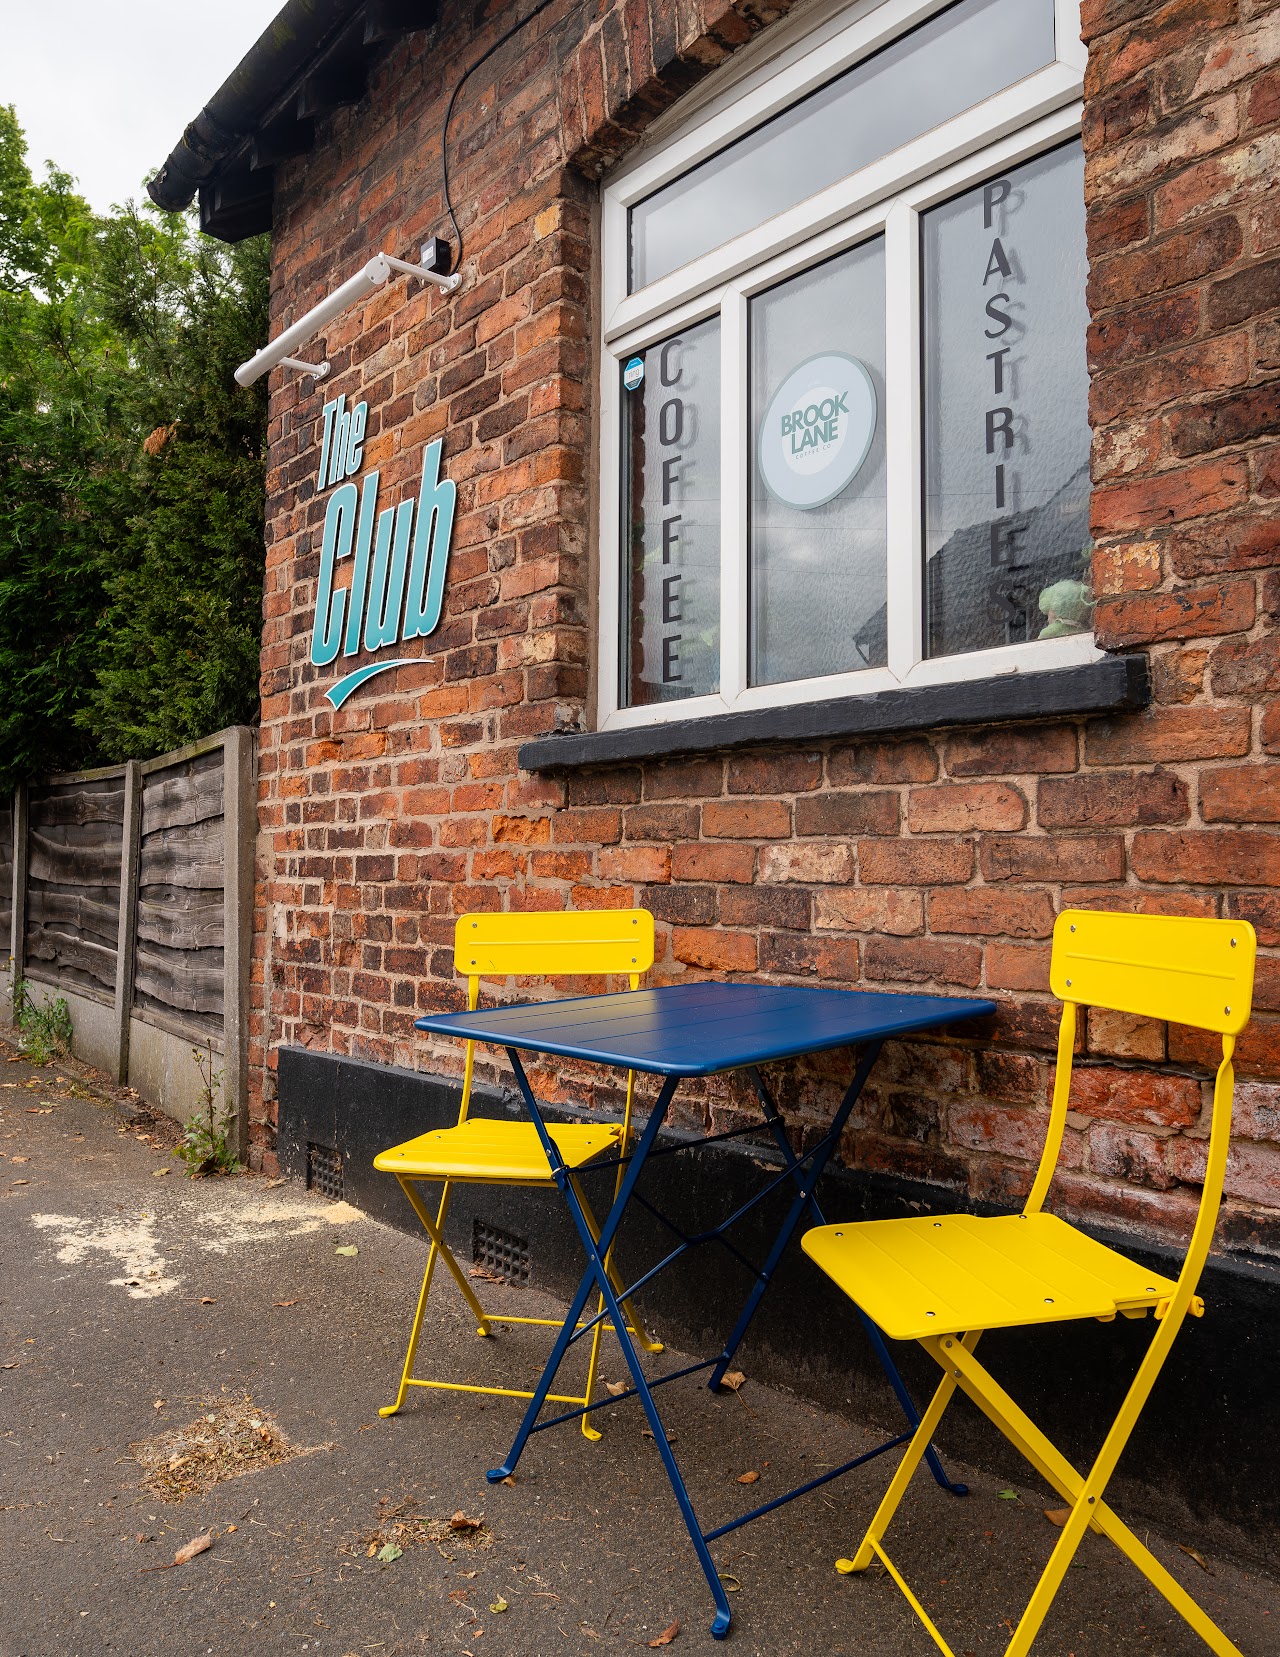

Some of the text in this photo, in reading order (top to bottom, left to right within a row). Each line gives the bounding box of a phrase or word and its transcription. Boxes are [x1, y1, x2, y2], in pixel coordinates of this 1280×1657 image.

[317, 393, 368, 491] The
[781, 391, 850, 437] BROOK
[791, 417, 838, 454] LANE
[982, 179, 1014, 626] PASTRIES
[310, 437, 457, 667] Club
[659, 338, 684, 683] COFFEE
